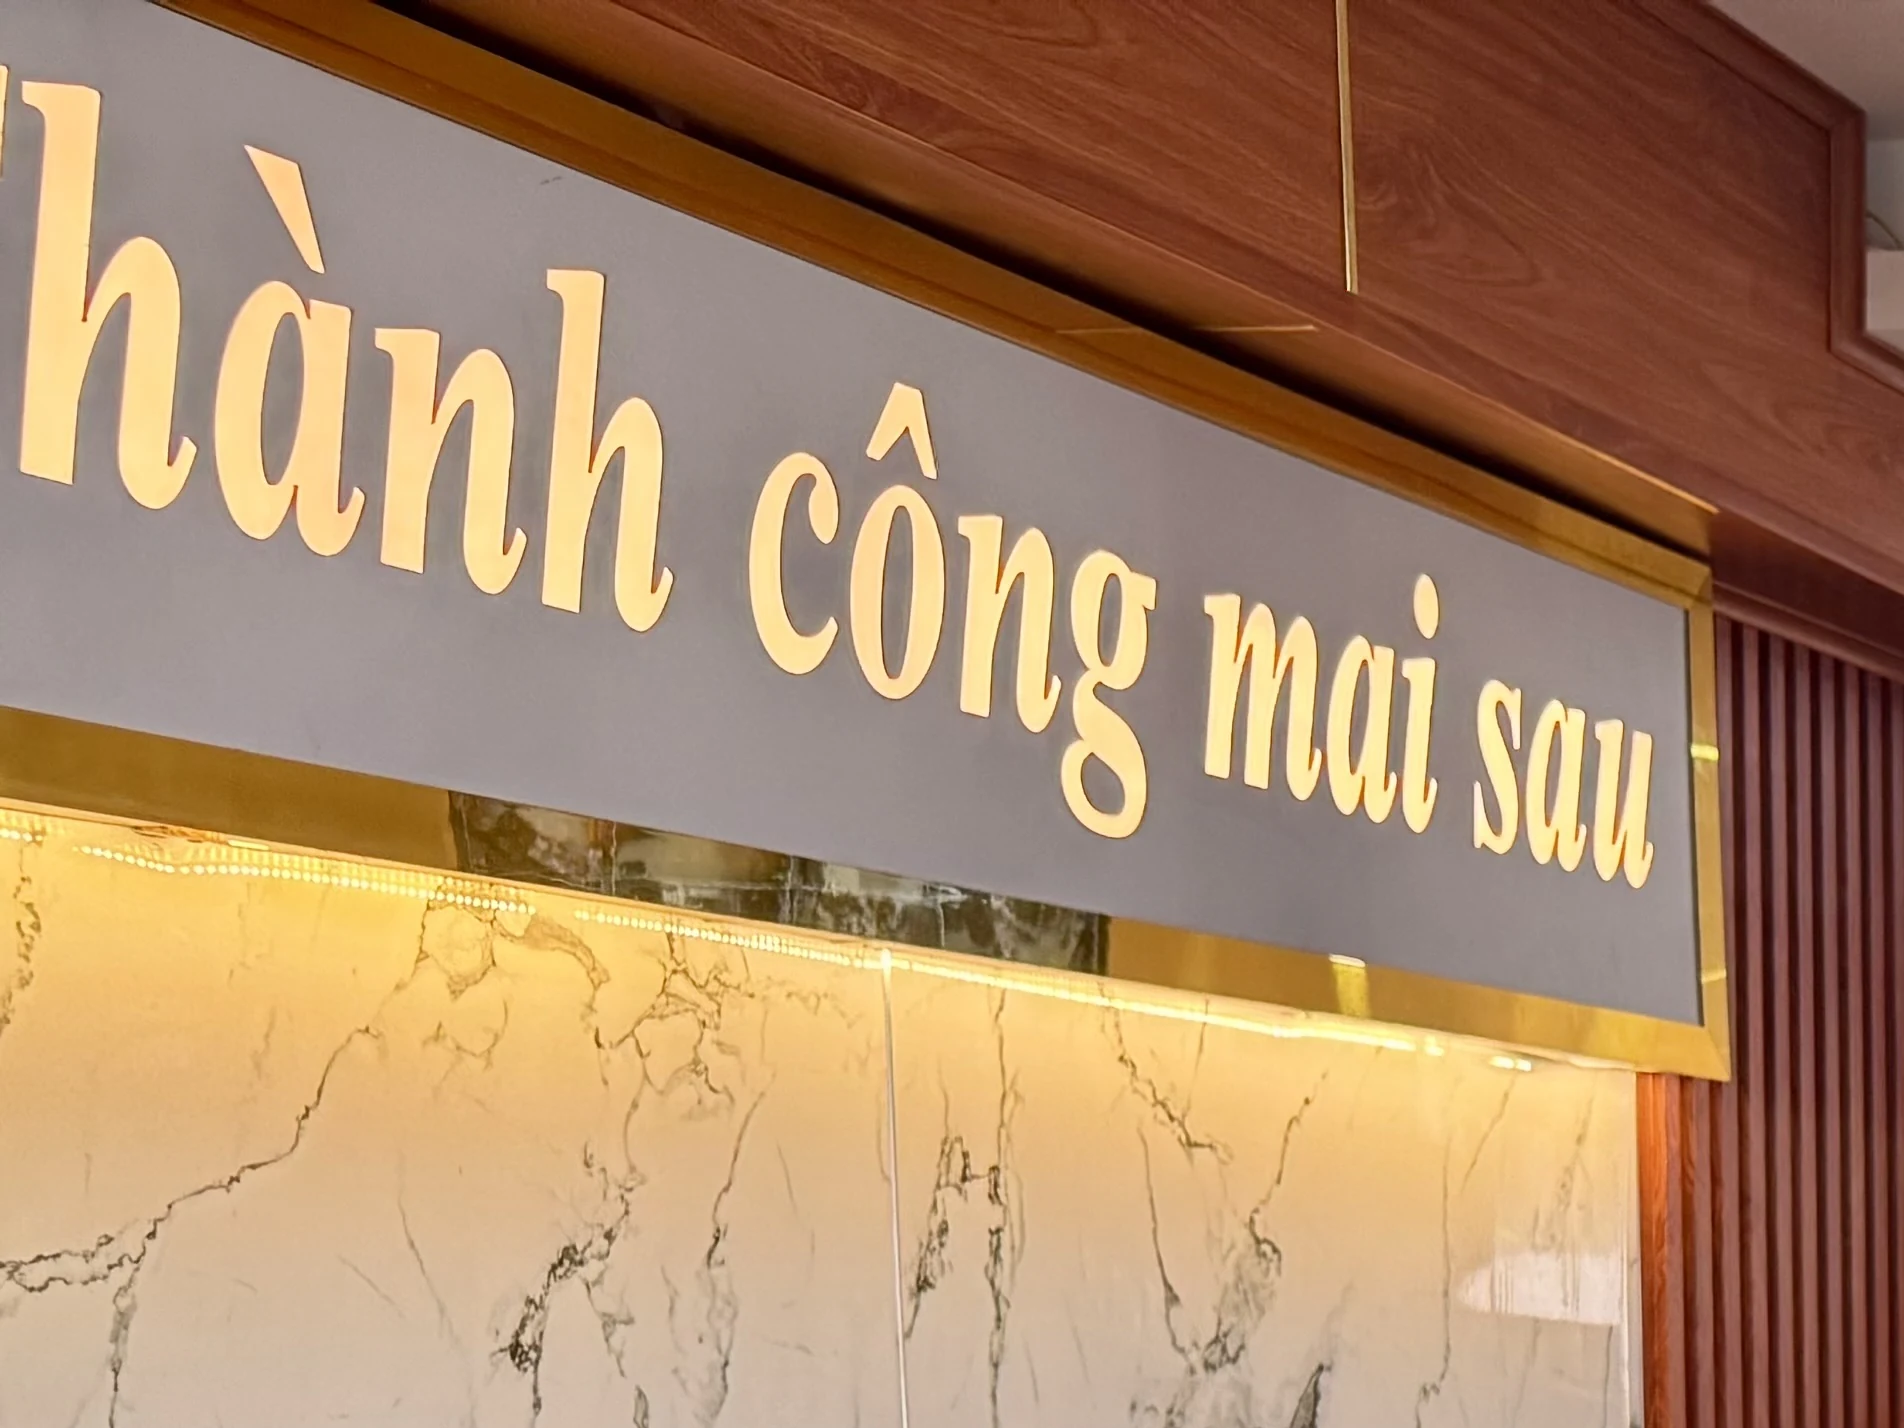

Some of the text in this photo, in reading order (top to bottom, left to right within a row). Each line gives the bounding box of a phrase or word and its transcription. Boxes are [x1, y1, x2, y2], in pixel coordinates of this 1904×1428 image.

[0, 64, 1654, 889] hành công mai sau
